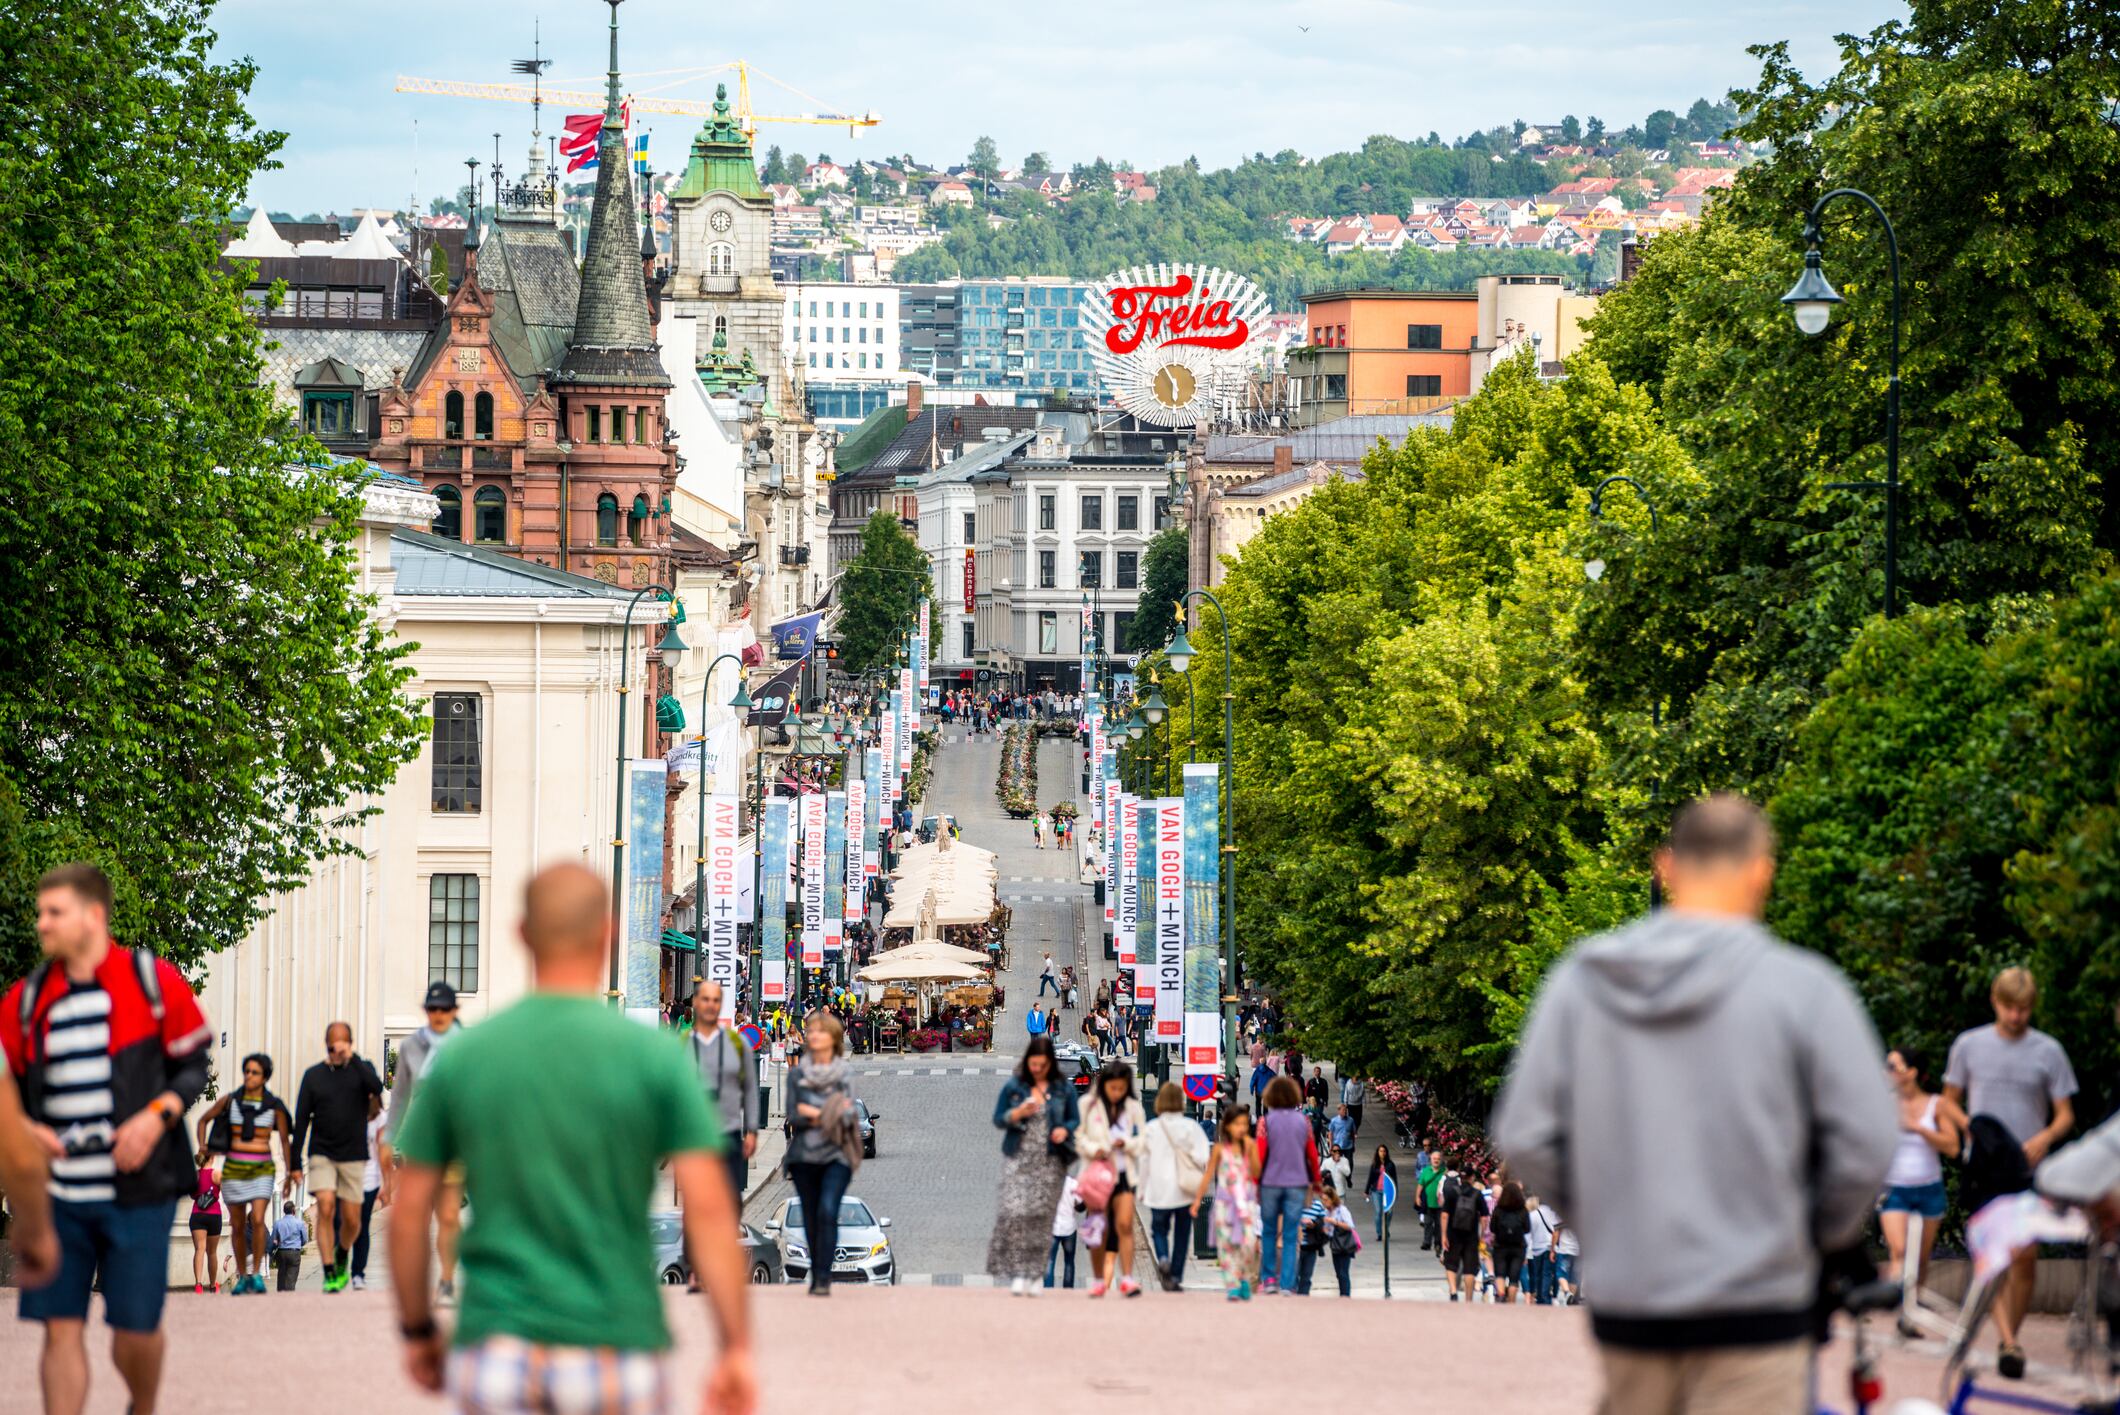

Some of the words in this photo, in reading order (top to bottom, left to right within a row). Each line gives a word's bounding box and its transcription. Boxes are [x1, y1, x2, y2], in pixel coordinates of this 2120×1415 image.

[1105, 274, 1248, 354] Freia
[460, 360, 479, 370] 1897
[1095, 739, 1104, 762] GOGH
[1108, 785, 1118, 806] VAN
[1124, 802, 1138, 828] VAN
[1162, 807, 1180, 842] VAN
[1124, 834, 1137, 868] GOGH
[1162, 850, 1180, 898] GOGH
[1124, 884, 1136, 932] MUNCH
[1161, 924, 1180, 990] MUNCH
